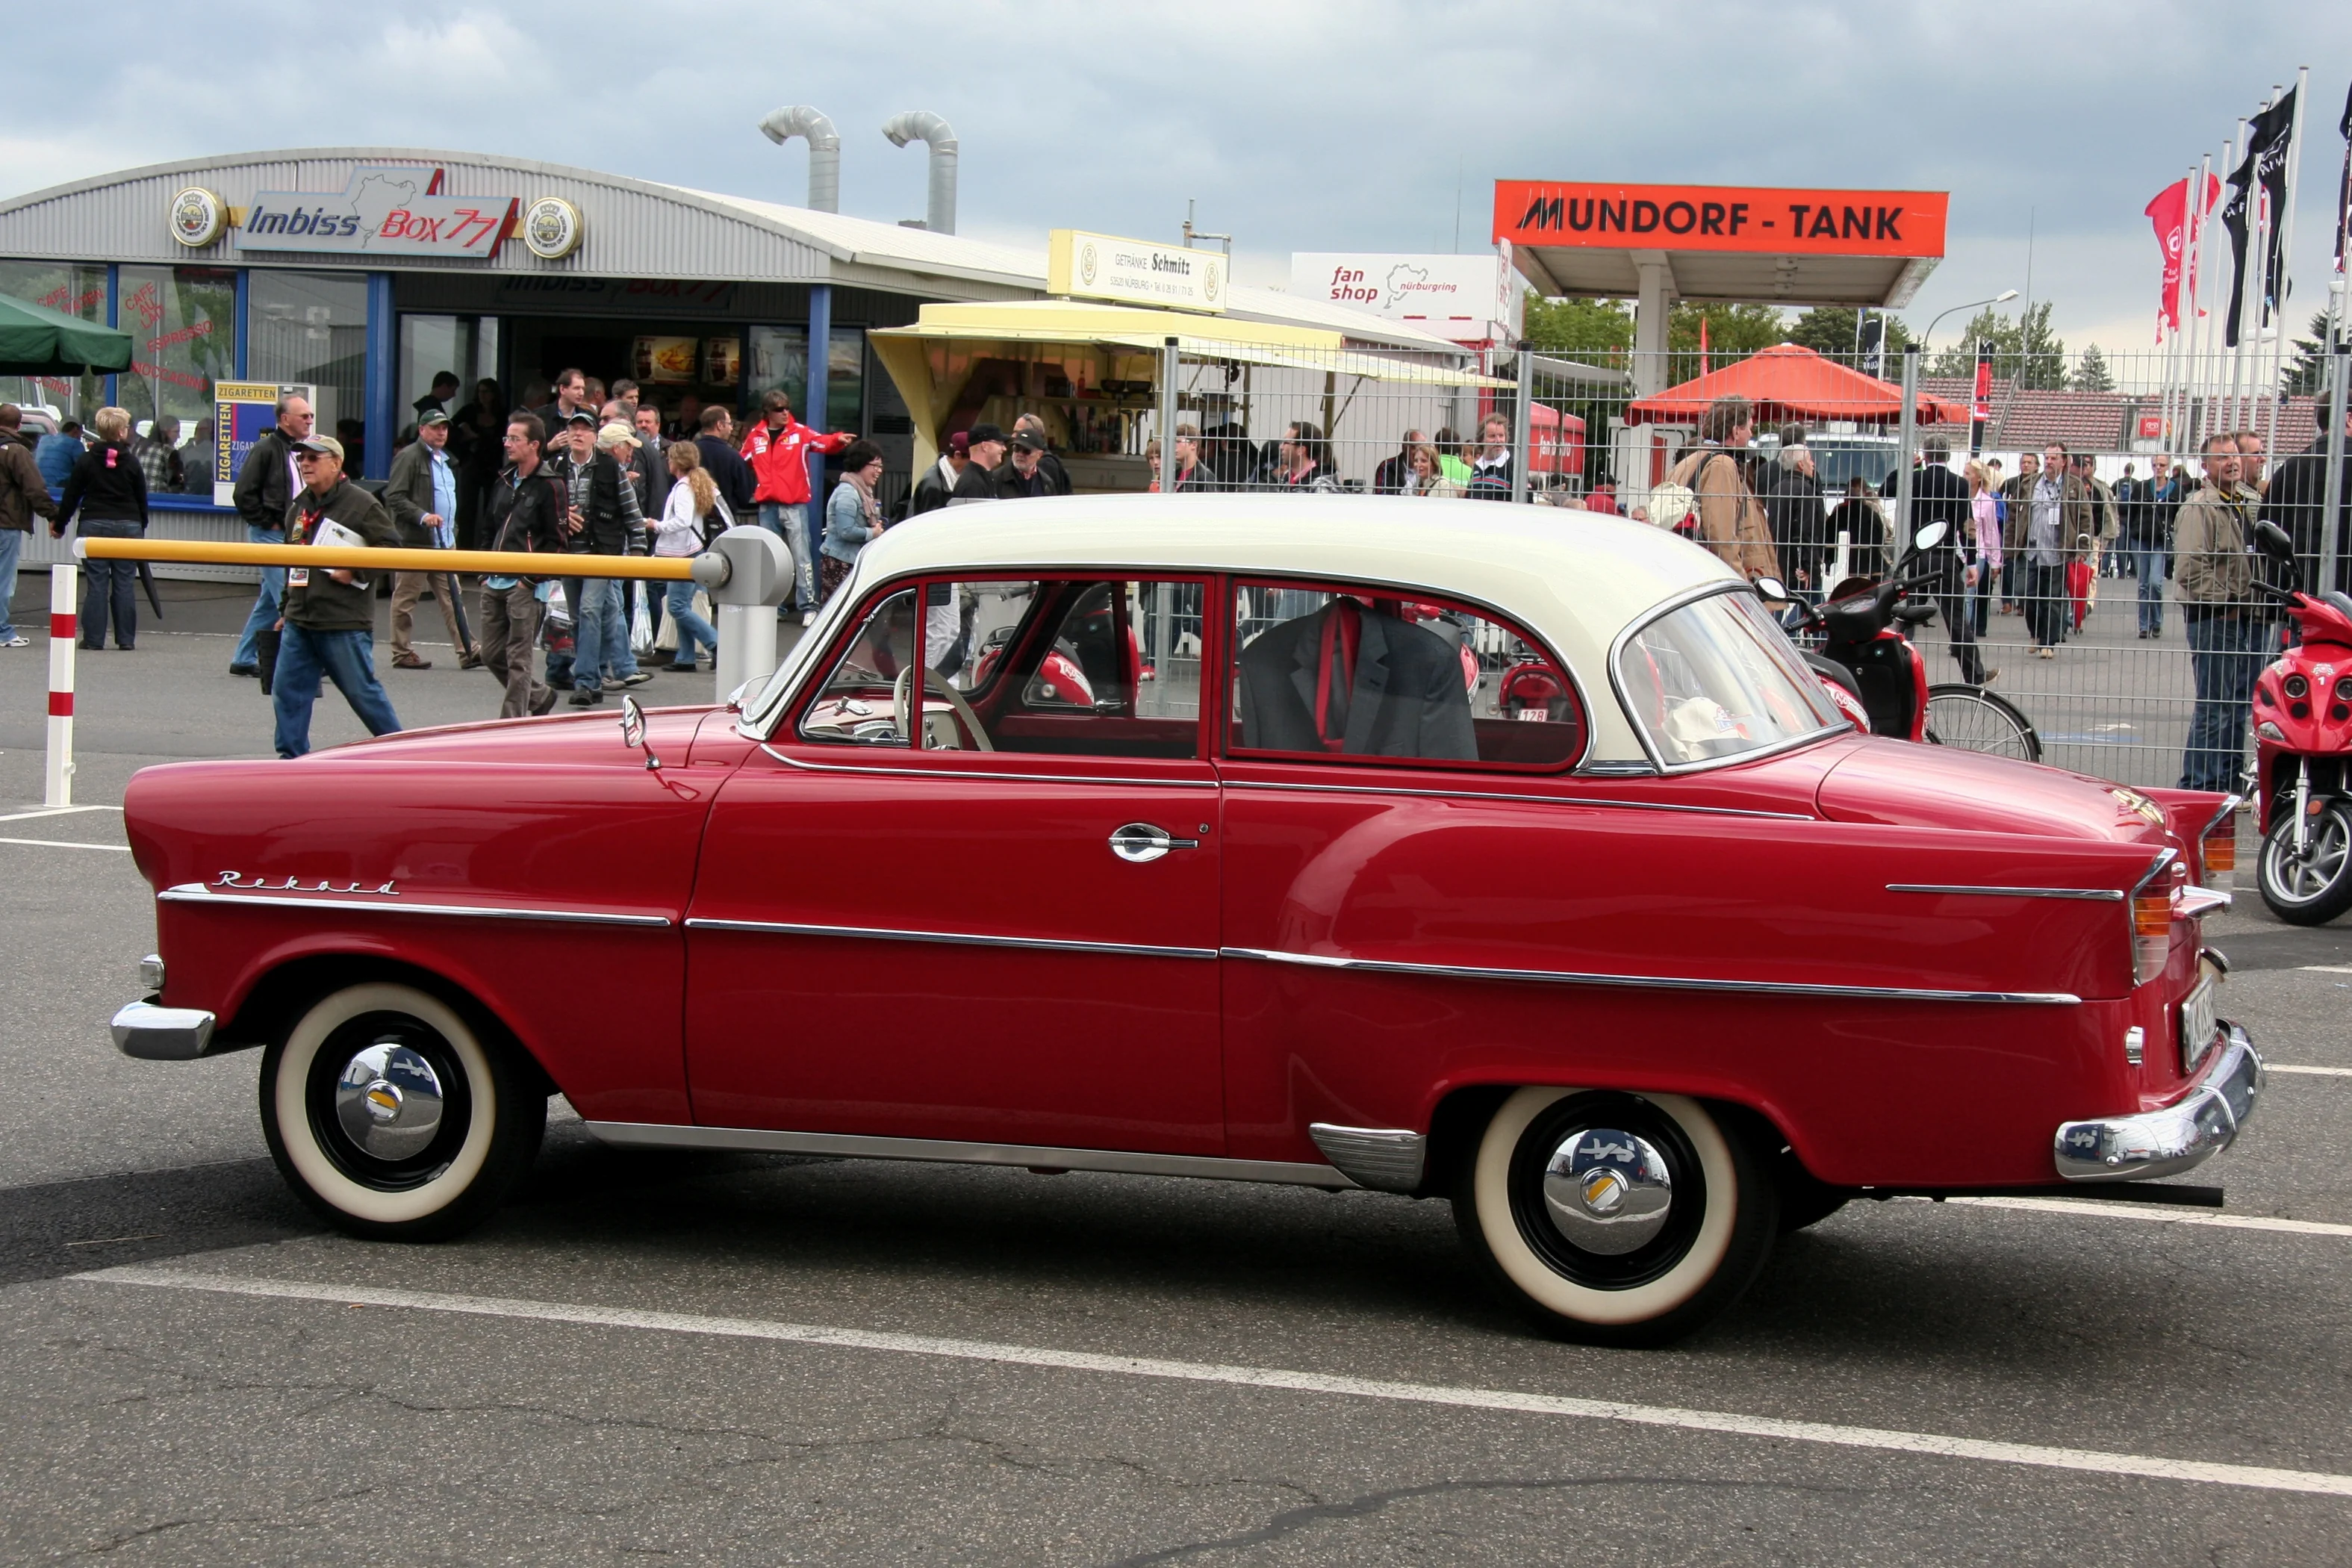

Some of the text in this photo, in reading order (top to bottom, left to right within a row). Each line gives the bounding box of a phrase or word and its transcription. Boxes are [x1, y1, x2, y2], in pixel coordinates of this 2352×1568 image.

[247, 206, 498, 248] Imbiss Box 77
[1516, 196, 1749, 236] MUNDORF
[1789, 205, 1903, 240] TANK
[1115, 252, 1190, 276] GETRÄNKE Schmitz
[1331, 266, 1364, 286] fan
[1330, 284, 1378, 304] shop
[1400, 281, 1457, 293] nürburgring
[146, 320, 214, 352] ESPRESSO
[218, 387, 276, 398] ZIGARETTEN
[219, 404, 231, 481] ZIGARETTEN
[2318, 676, 2326, 685] 1
[211, 871, 399, 895] Rekord
